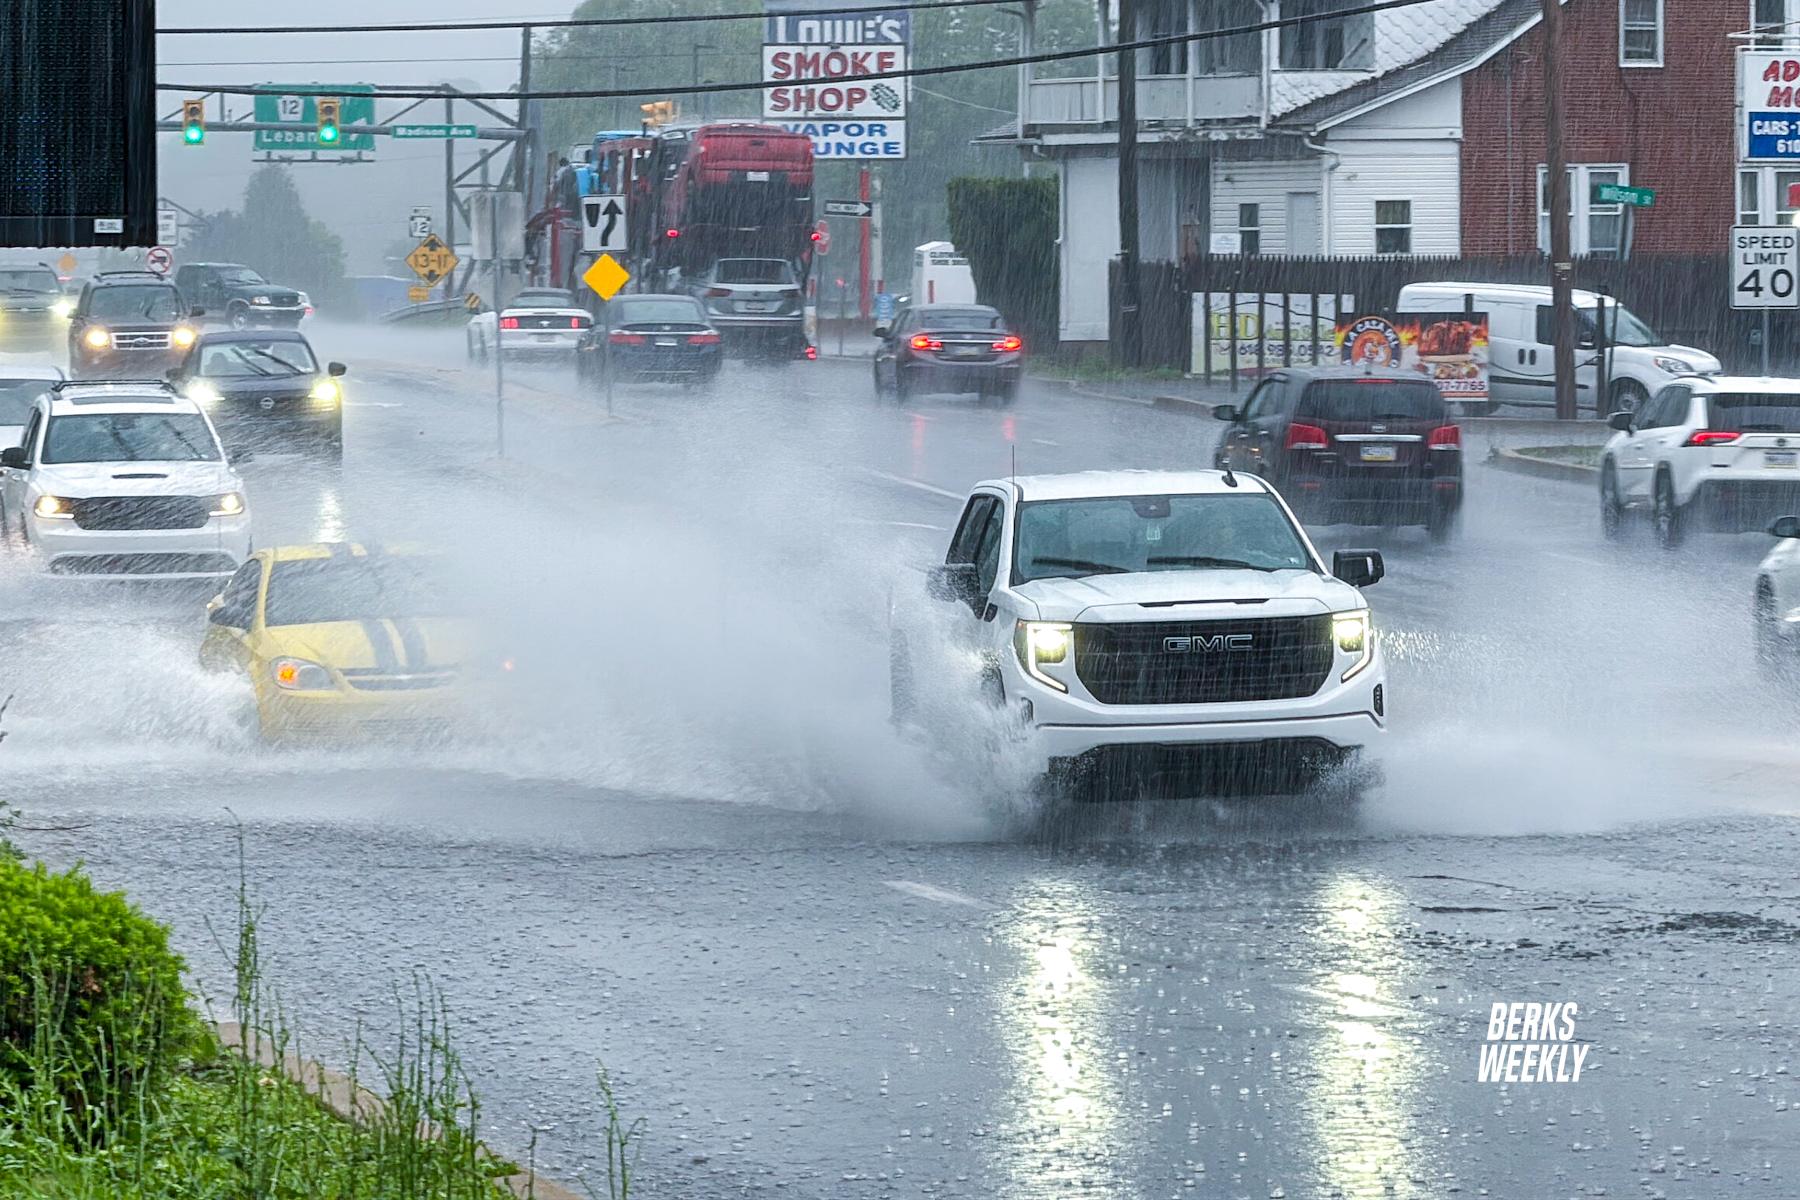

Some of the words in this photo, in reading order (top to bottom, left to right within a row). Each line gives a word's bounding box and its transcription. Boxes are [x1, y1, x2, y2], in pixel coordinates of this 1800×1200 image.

[775, 15, 903, 43] LOUIE'S
[770, 51, 897, 80] SMOKE
[770, 87, 868, 112] SHOP
[281, 100, 299, 115] 12
[262, 129, 319, 143] Leban
[396, 127, 446, 136] Madison
[450, 127, 472, 136] Ave
[783, 124, 887, 137] VAPOR
[812, 142, 901, 155] UNGE
[413, 221, 428, 233] 12
[1737, 236, 1795, 249] SPEED
[1743, 252, 1788, 265] LIMIT
[1737, 268, 1794, 298] 40
[1163, 634, 1253, 653] GMC
